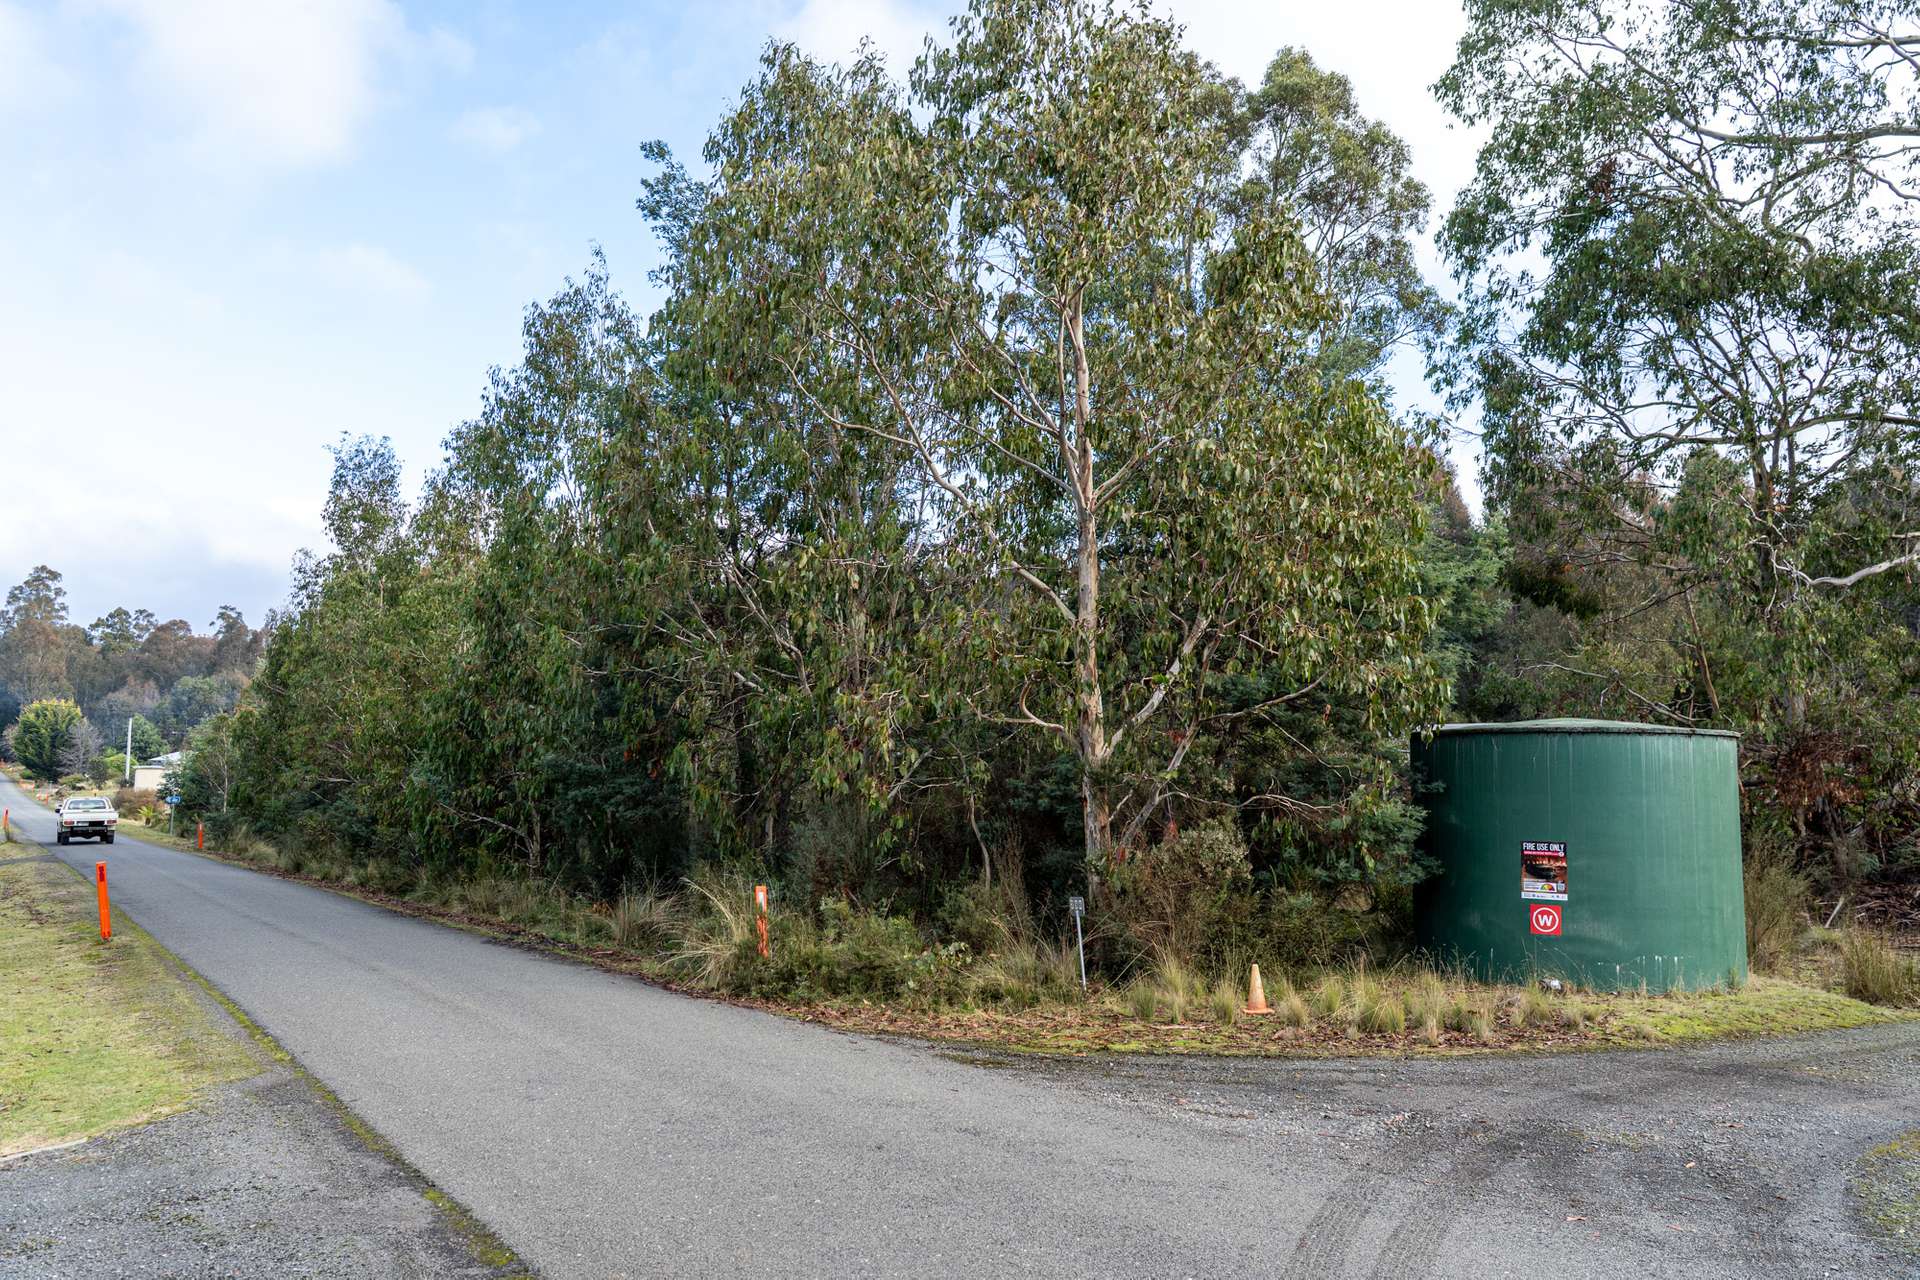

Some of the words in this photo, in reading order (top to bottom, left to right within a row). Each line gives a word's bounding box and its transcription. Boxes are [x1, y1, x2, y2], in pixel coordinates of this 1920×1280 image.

[1523, 842, 1536, 850] FIRE
[1537, 843, 1549, 851] USE
[1550, 844, 1565, 852] ONLY
[1538, 914, 1553, 927] W
